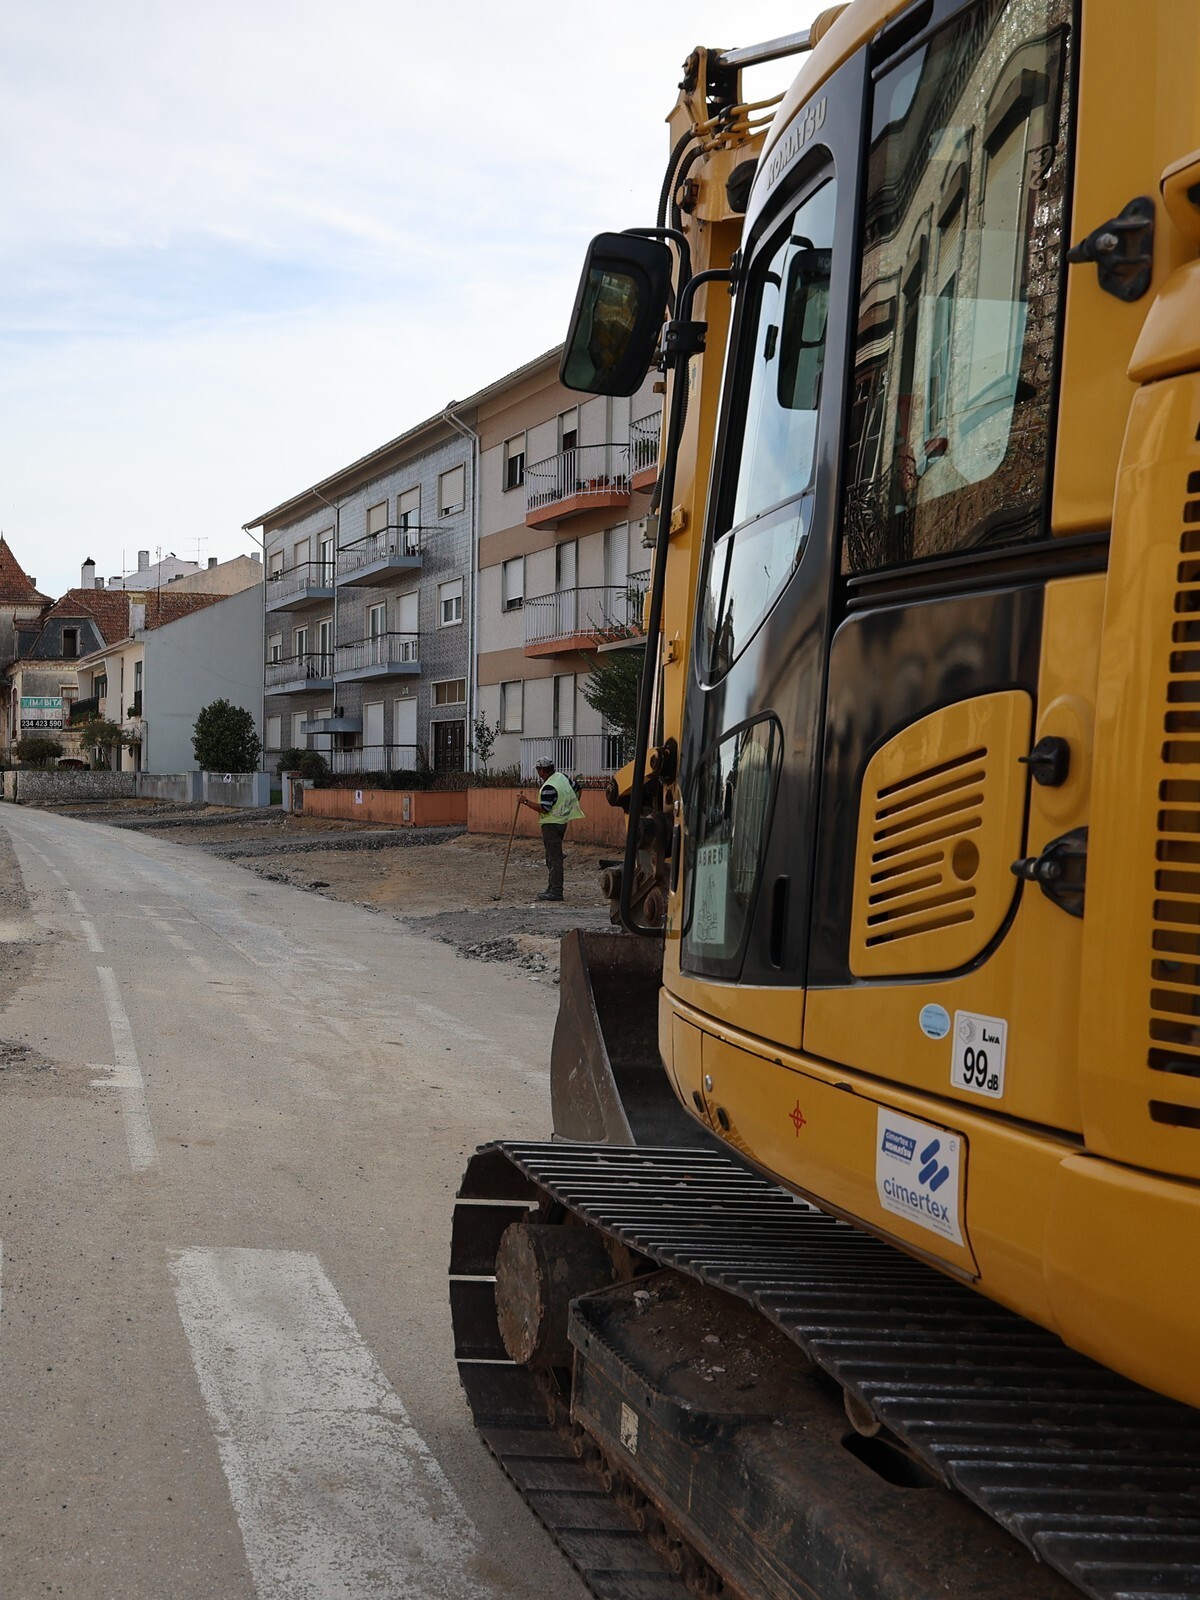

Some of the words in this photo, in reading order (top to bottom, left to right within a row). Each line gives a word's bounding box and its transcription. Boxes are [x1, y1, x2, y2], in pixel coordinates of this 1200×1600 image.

[767, 96, 827, 191] KOMATSU
[962, 1046, 988, 1088] 99
[987, 1073, 999, 1091] dB
[883, 1177, 950, 1224] cimertex
